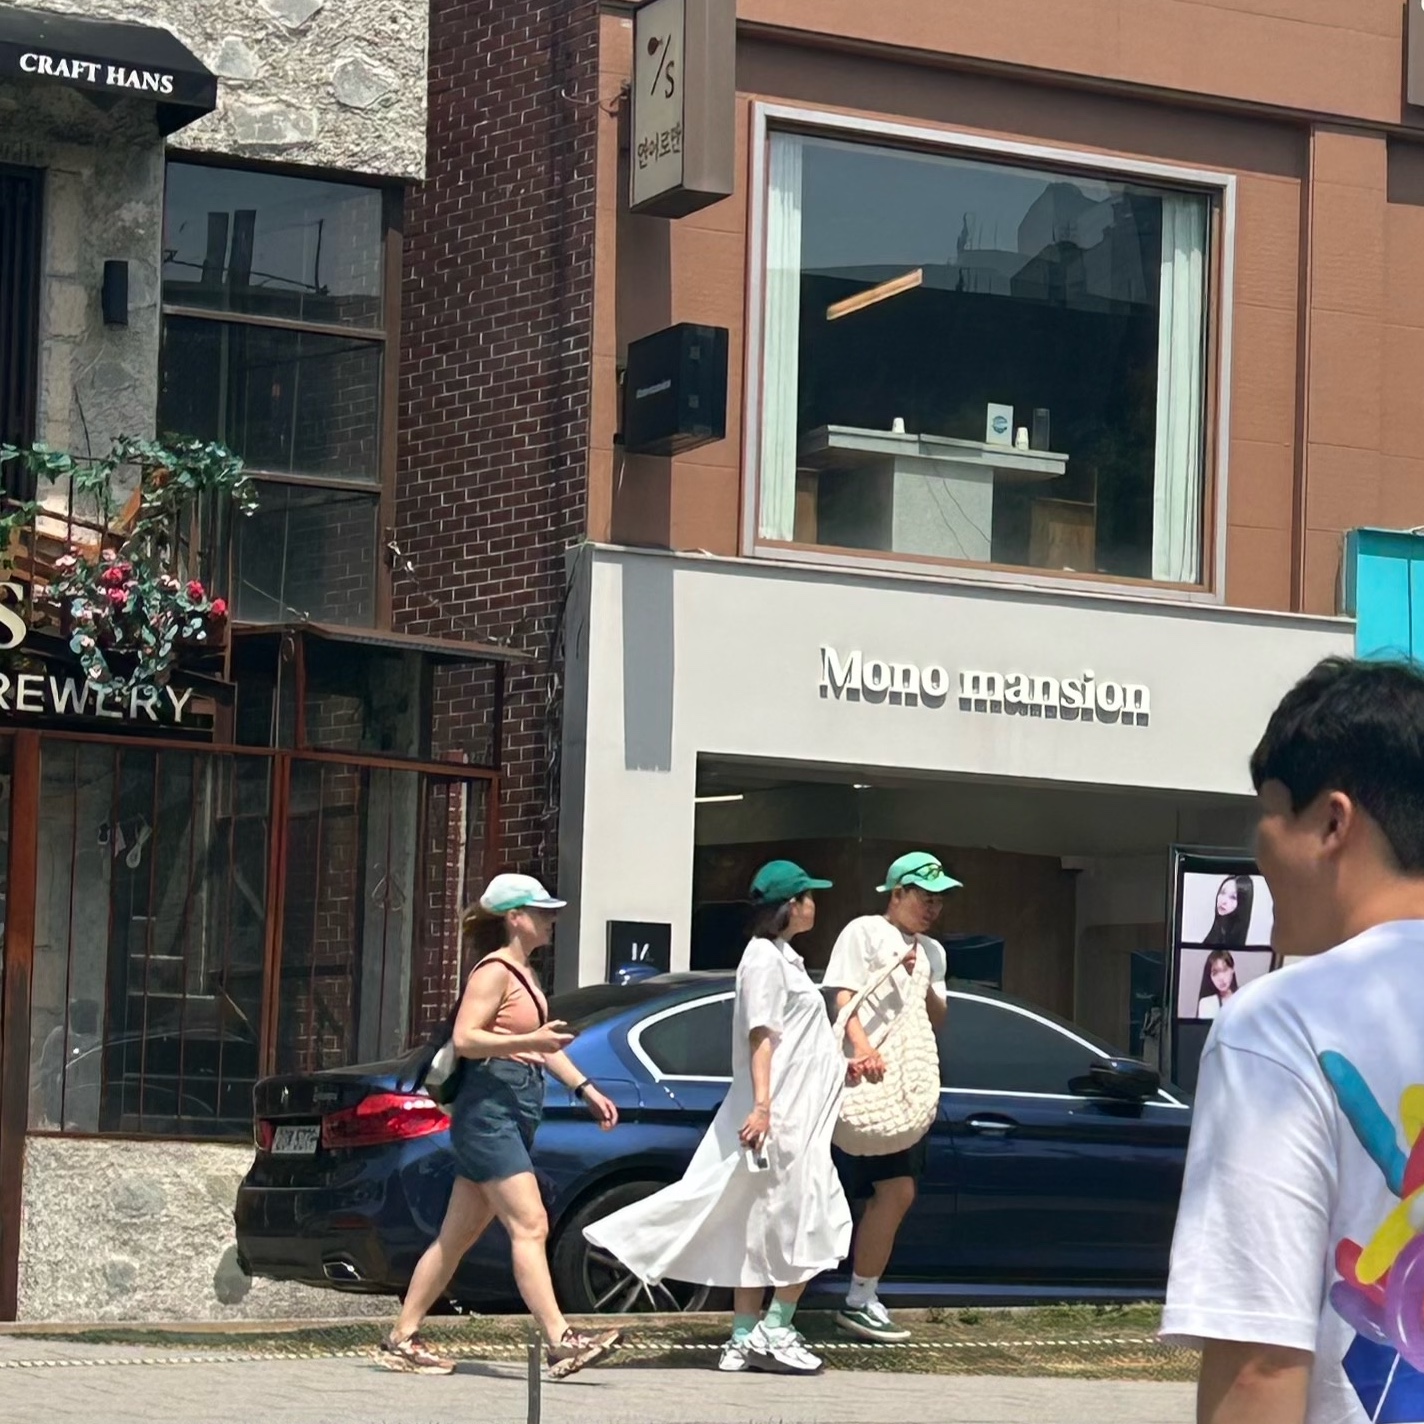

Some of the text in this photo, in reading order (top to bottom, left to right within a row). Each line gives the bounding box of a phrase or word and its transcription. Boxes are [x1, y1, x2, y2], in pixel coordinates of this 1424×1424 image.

[18, 52, 174, 95] CRAFT HANS
[819, 645, 1150, 715] Mono mansion
